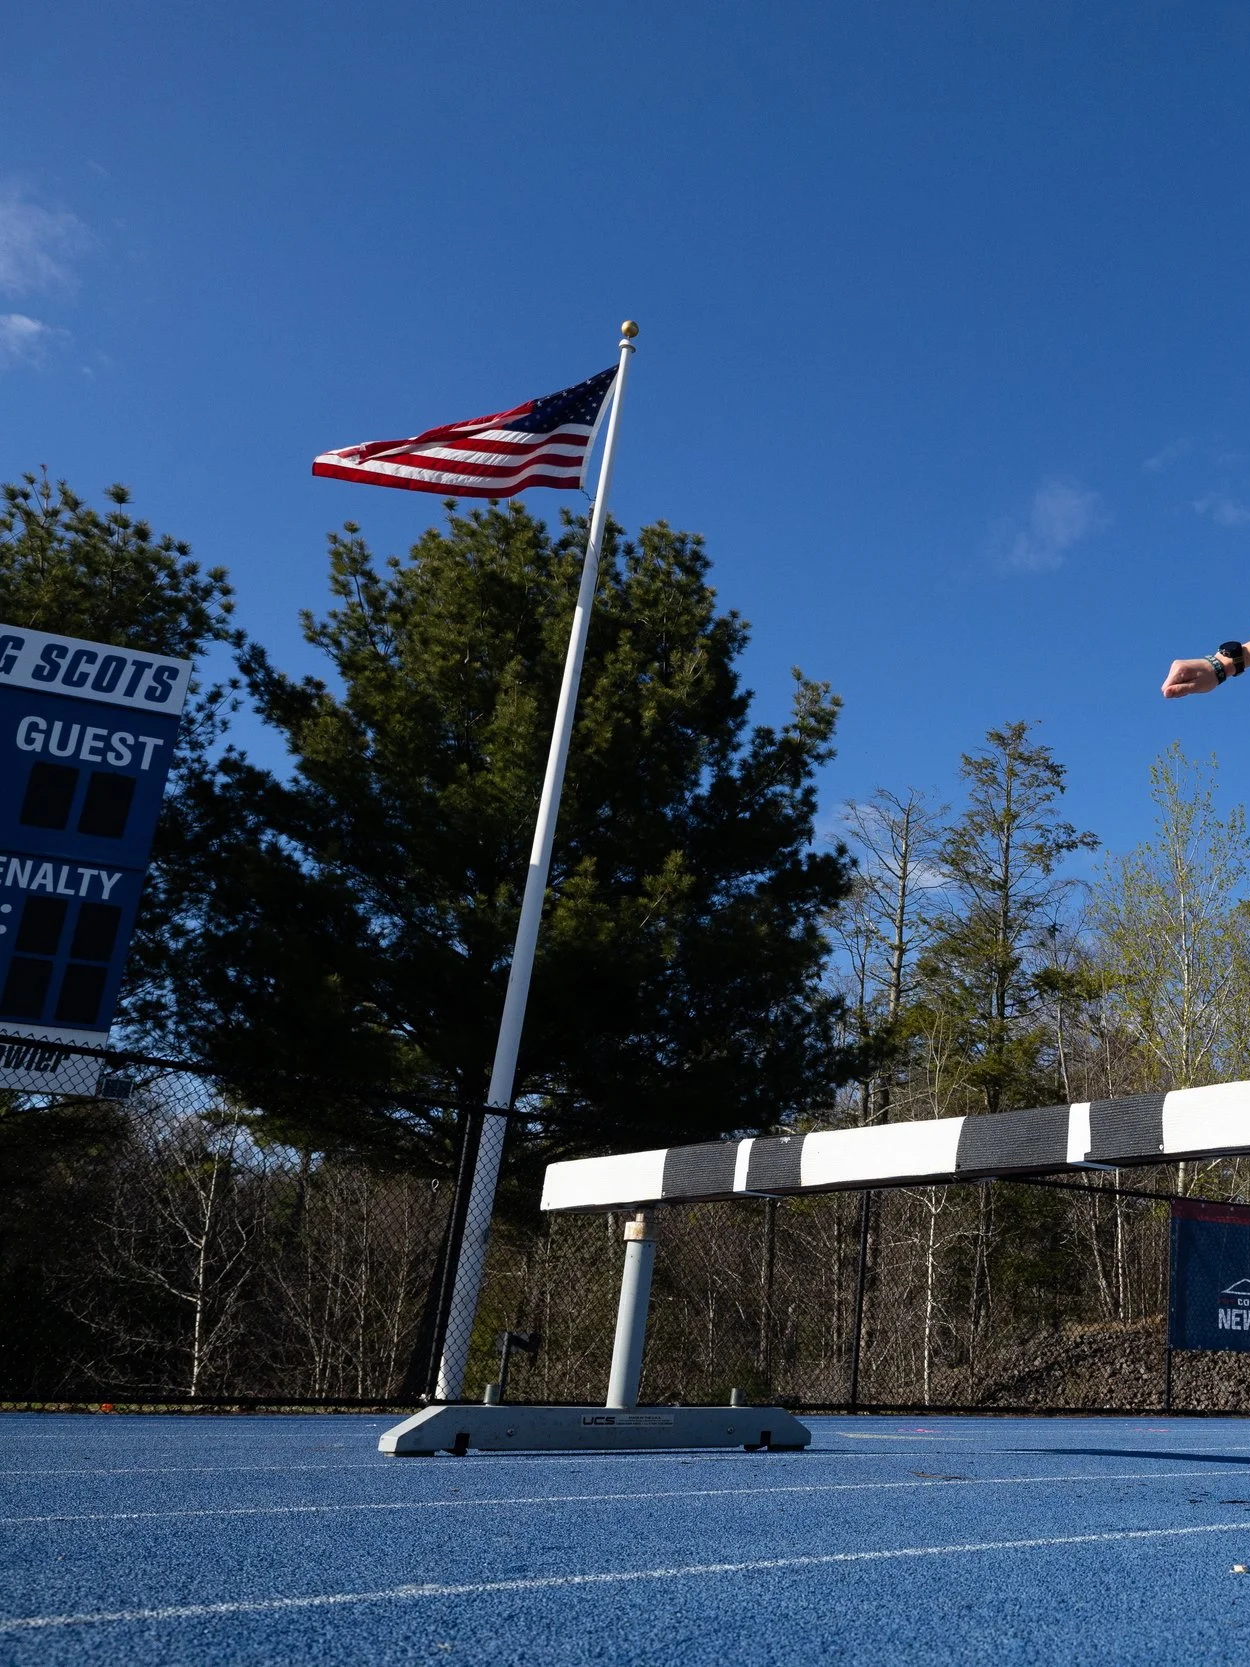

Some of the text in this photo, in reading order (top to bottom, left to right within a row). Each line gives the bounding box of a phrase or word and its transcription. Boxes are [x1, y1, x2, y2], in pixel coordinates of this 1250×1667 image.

[31, 643, 180, 703] SCOTS
[16, 715, 164, 771] GUEST
[583, 1416, 616, 1426] UCS
